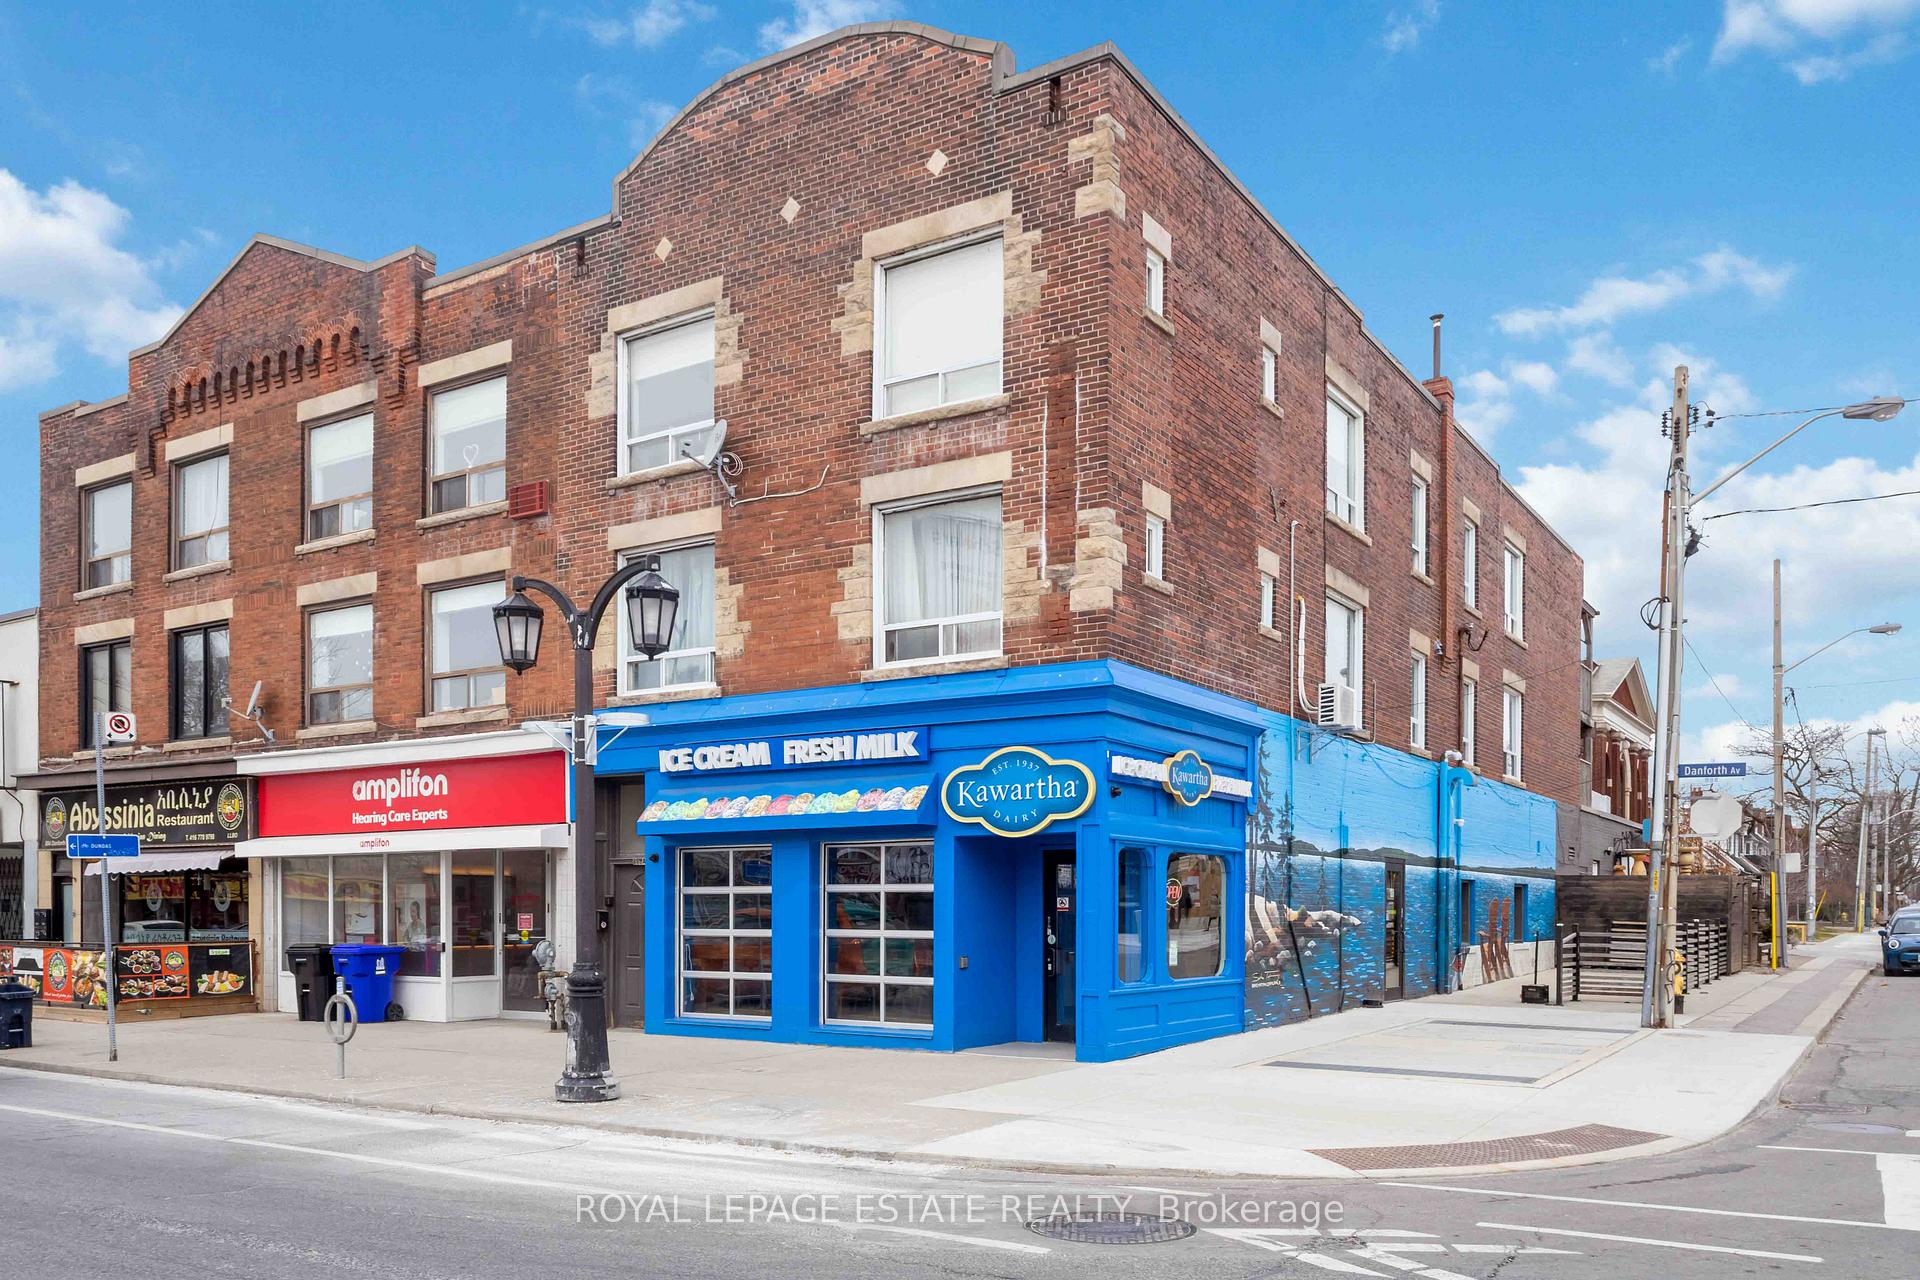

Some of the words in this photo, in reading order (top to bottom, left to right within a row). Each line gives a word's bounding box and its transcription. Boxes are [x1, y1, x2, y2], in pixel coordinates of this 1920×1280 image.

[659, 748, 693, 773] ICE
[693, 741, 771, 771] CREAM
[783, 735, 854, 765] FRESH
[855, 731, 920, 760] MILK
[991, 760, 1012, 775] EST.
[1016, 759, 1040, 772] 1937
[1684, 765, 1728, 776] Danforth
[1730, 766, 1741, 774] Av
[1172, 767, 1208, 786] Kawartha
[352, 768, 448, 807] amplifon
[957, 774, 1077, 808] Kawartha
[69, 798, 154, 832] Abyssinia
[156, 812, 215, 827] Restaurant
[352, 811, 387, 827] Hearing
[388, 810, 410, 823] Care
[412, 809, 448, 824] Experts
[993, 808, 1038, 824] DAIRY
[360, 837, 389, 851] amplifon
